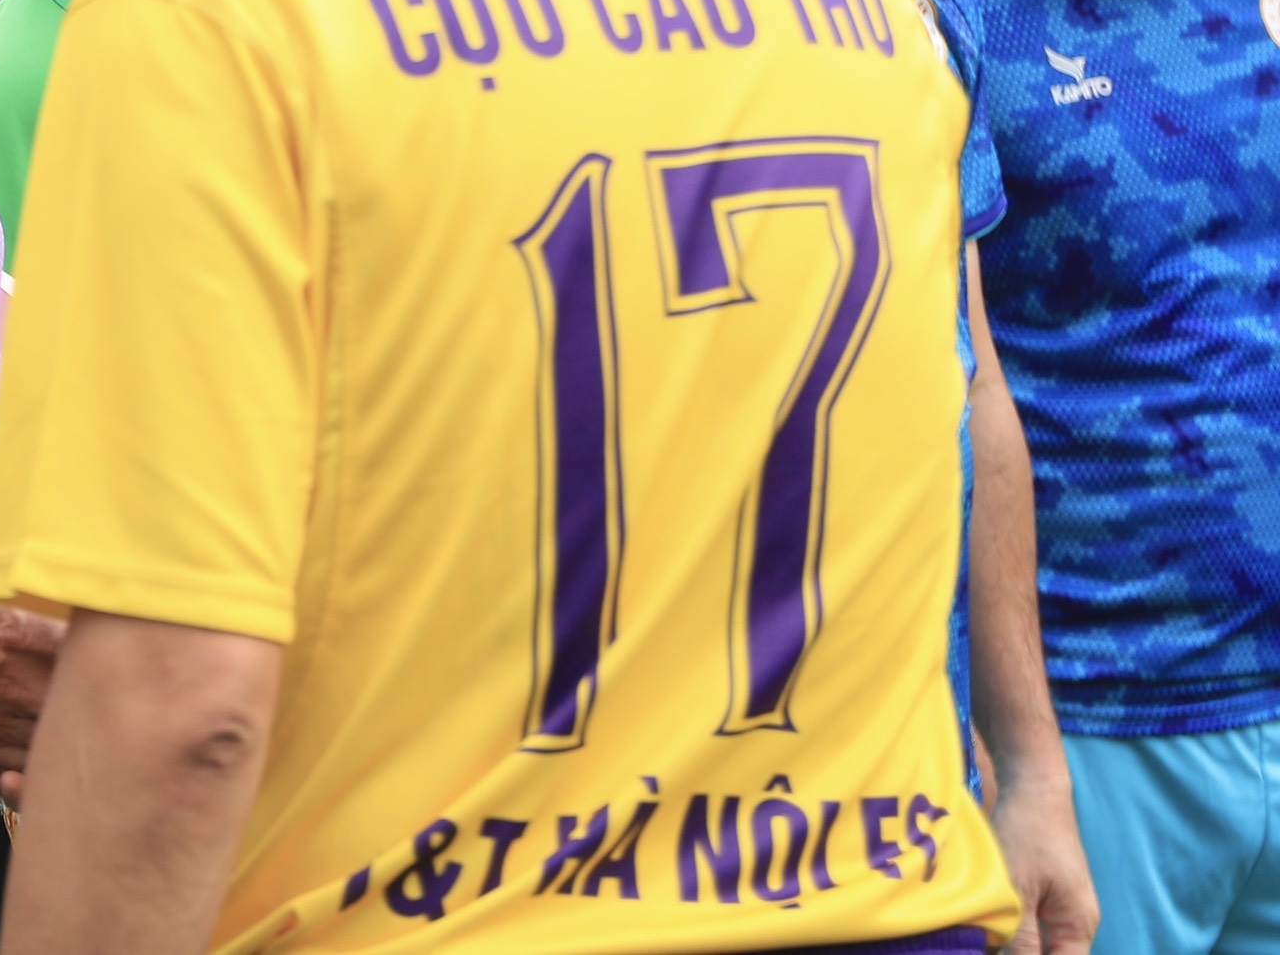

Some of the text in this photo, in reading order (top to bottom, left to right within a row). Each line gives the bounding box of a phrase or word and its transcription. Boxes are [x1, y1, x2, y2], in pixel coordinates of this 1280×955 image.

[511, 136, 892, 754] 17
[533, 775, 659, 900] HÀ
[677, 774, 840, 909] NỘI
